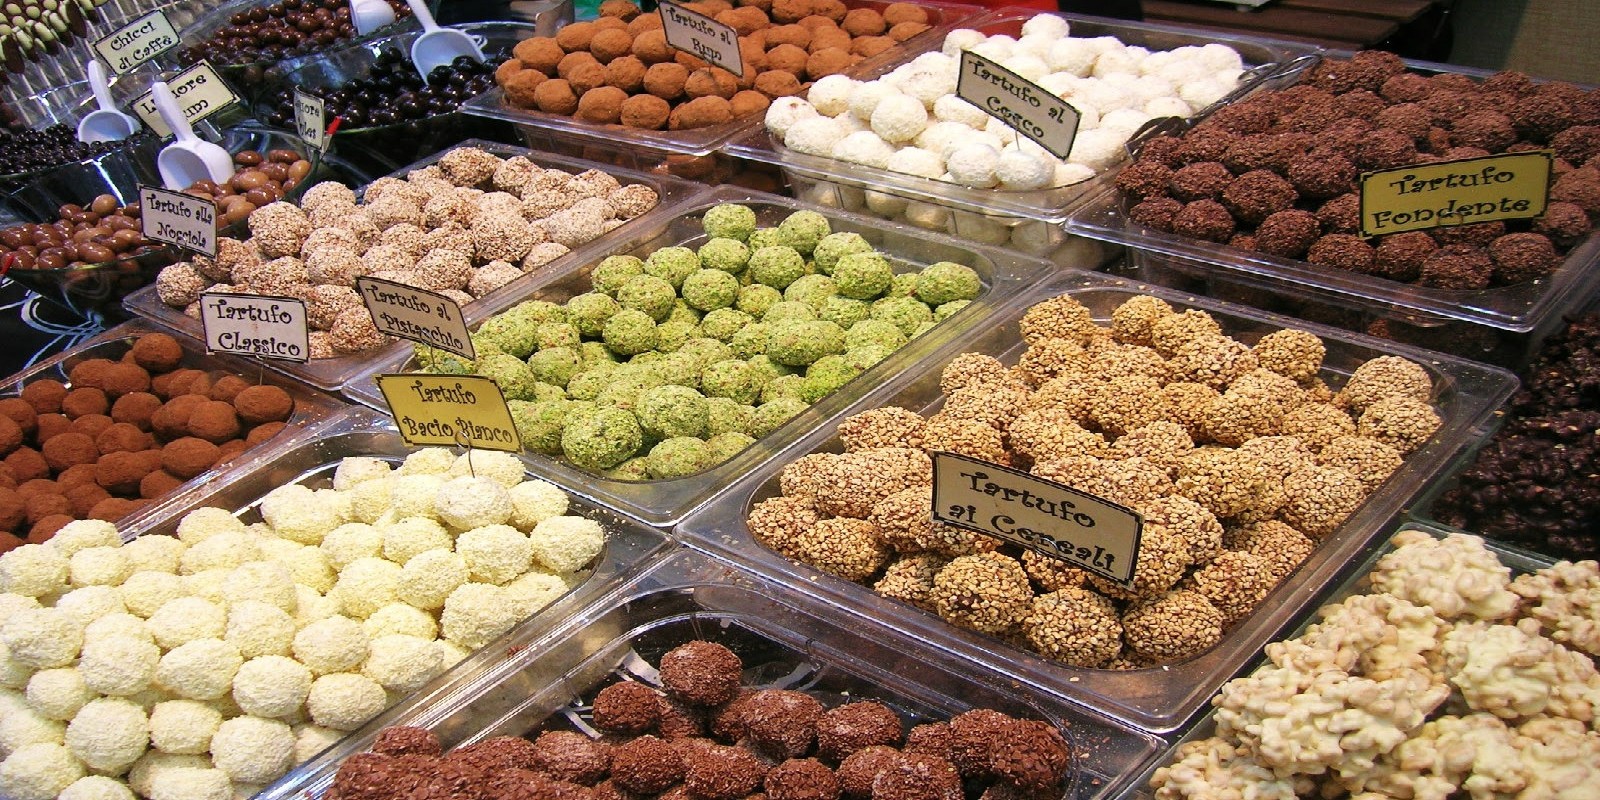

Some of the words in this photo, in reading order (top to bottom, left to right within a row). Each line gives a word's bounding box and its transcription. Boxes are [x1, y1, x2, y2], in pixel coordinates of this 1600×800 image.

[666, 7, 716, 37] Tartufo
[720, 31, 732, 46] al
[119, 56, 132, 70] di
[691, 37, 722, 61] Rum
[968, 60, 1041, 108] Tartufo
[1048, 107, 1063, 124] al
[987, 96, 1044, 138] Cocco
[1390, 166, 1514, 195] Tartufo
[146, 193, 191, 218] Tartufo
[195, 206, 212, 225] alla
[1372, 197, 1531, 229] Fondente
[157, 222, 206, 248] Nocciola
[209, 299, 292, 324] Tartufo
[365, 284, 430, 313] Tartufo
[436, 303, 452, 321] al
[218, 331, 300, 356] Classico
[380, 311, 463, 350] Pistacchio
[411, 380, 476, 404] Tartufo
[402, 415, 454, 437] Bacio
[455, 416, 513, 443] Bianco
[960, 471, 1096, 528] Tartufo
[949, 504, 977, 523] ai
[990, 514, 1117, 573] Cereali
